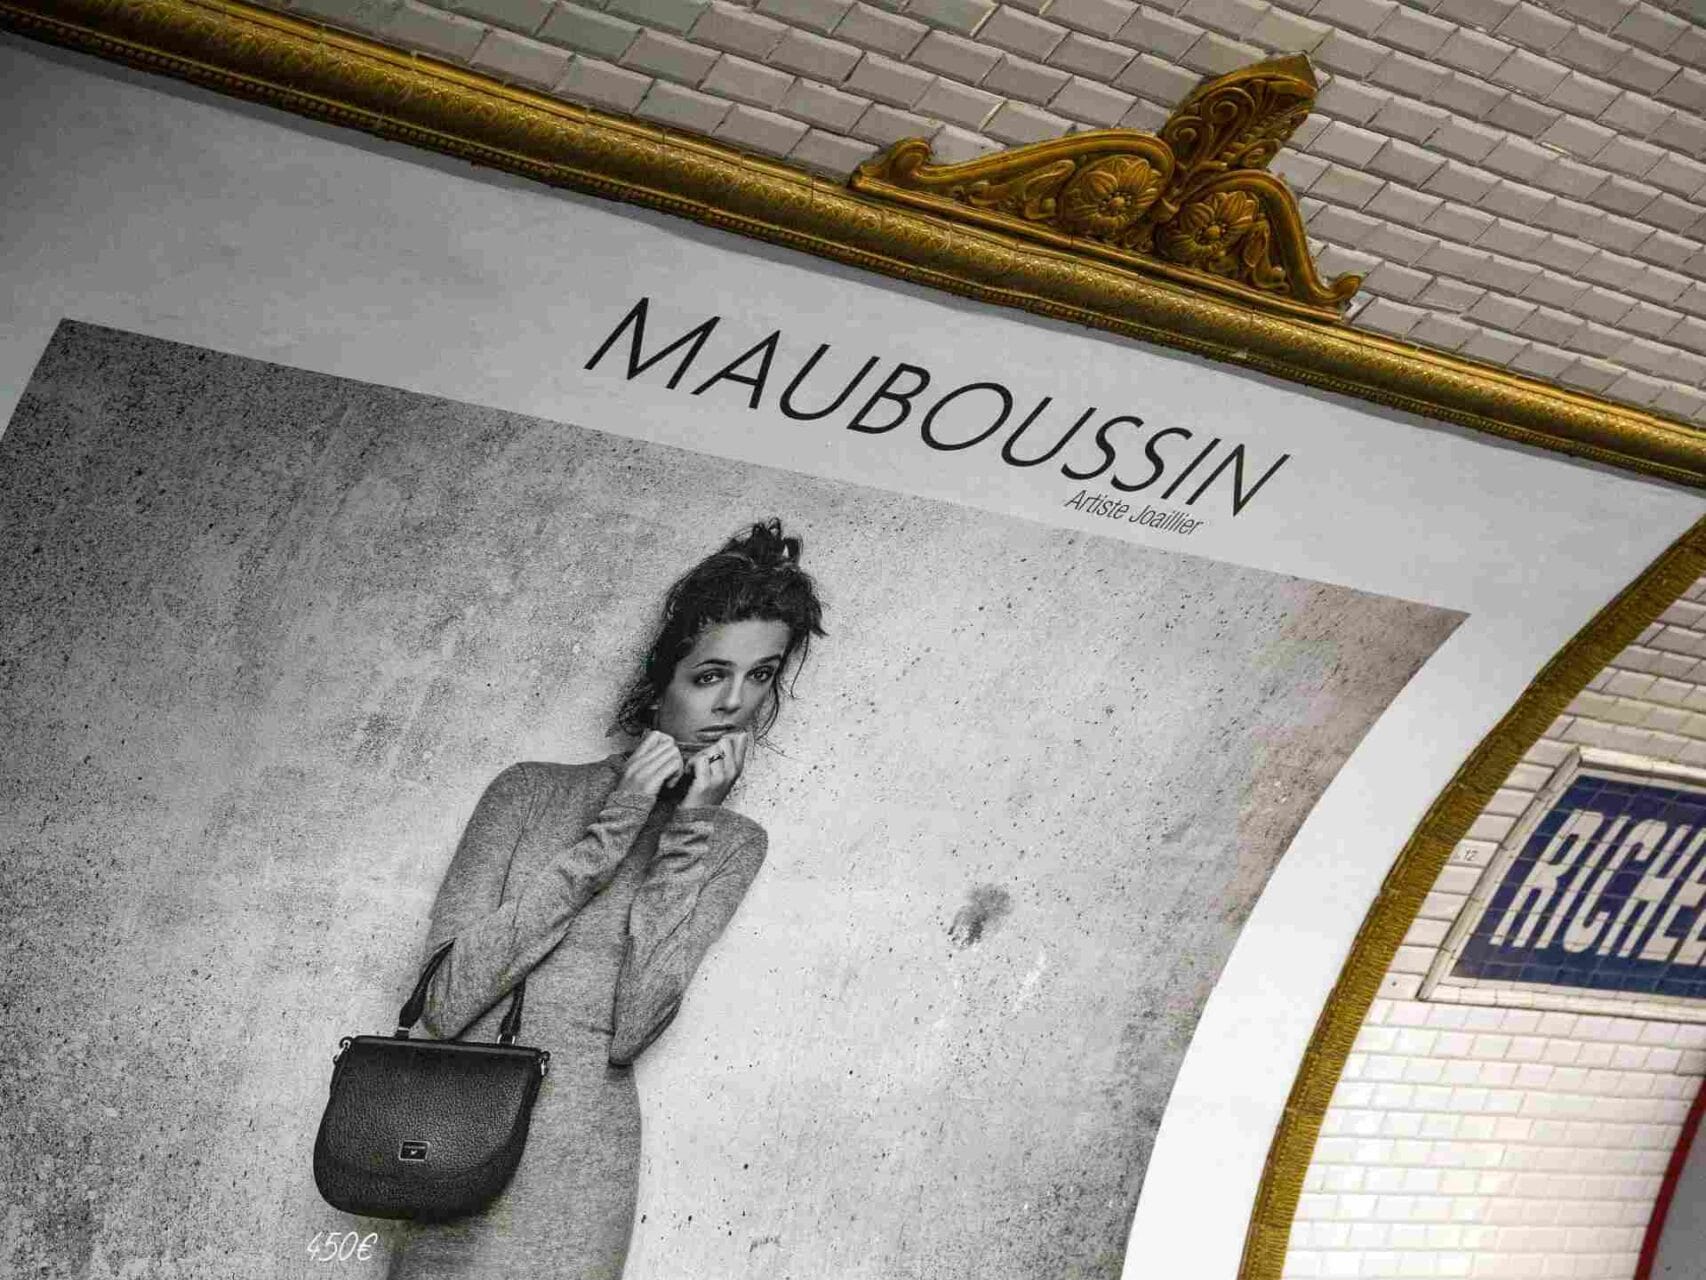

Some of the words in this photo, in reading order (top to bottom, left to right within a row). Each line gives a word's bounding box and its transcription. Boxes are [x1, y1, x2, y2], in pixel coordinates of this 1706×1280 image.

[583, 296, 1290, 517] MAUBOUSSIN
[1064, 489, 1130, 520] Artiste
[1128, 504, 1205, 535] Joaillier
[307, 1231, 378, 1261] 450€
